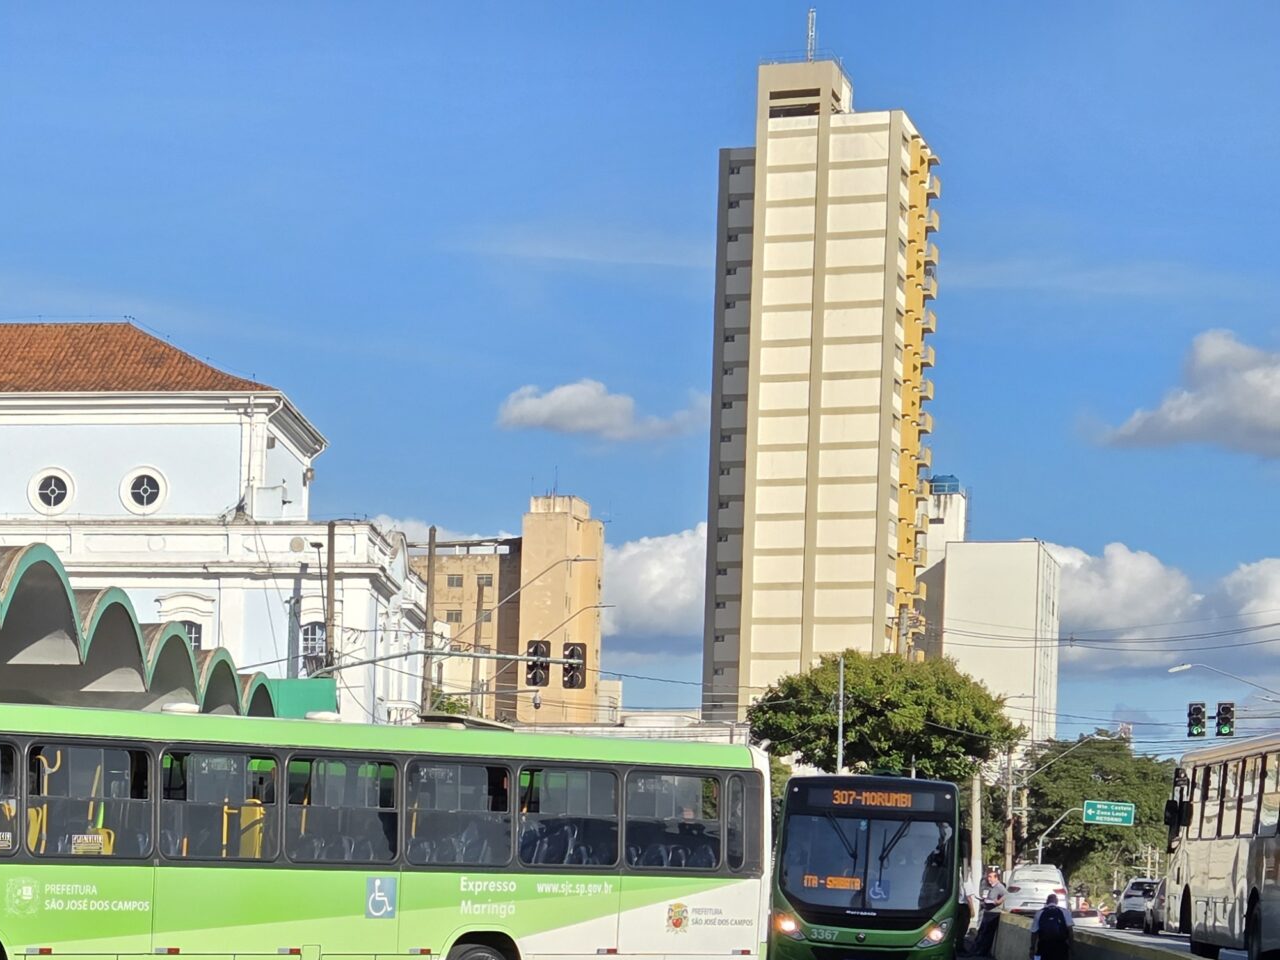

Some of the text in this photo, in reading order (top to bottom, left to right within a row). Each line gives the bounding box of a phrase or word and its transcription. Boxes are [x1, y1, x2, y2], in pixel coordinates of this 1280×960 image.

[832, 790, 912, 808] 307-MORUMBI
[44, 884, 98, 895] PREFEITURA
[460, 877, 516, 895] Expresso
[536, 881, 612, 896] www.sjc.sp.gov.br
[44, 900, 150, 911] SÃO JOSÉ DOS CAMPOS
[460, 900, 516, 918] Maringá
[692, 918, 702, 926] SÃO
[704, 918, 716, 926] JOSÉ
[810, 929, 839, 940] 3367
